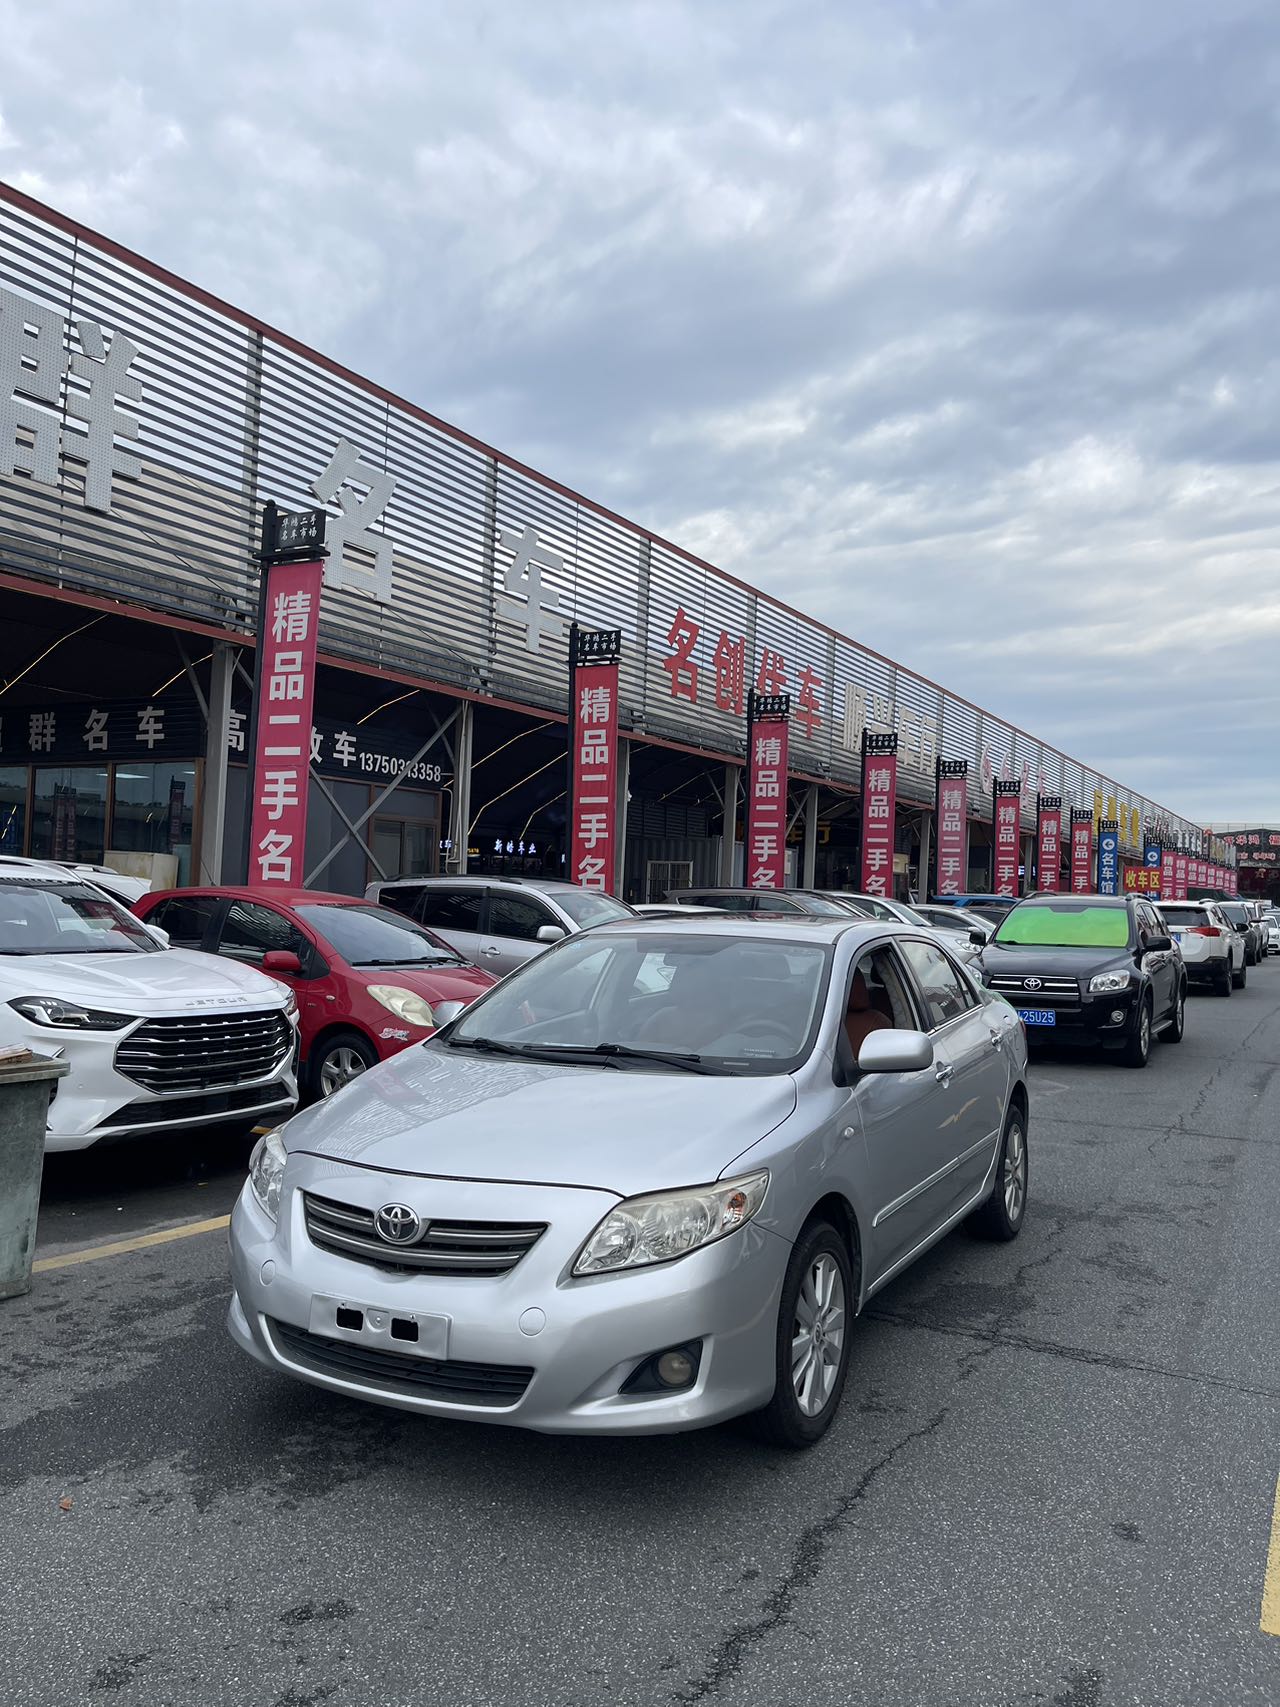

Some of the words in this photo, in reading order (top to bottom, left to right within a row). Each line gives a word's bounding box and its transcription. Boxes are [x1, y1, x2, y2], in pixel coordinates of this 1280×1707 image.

[0, 706, 166, 752] 群名车
[258, 590, 311, 882] 精品二手名
[577, 686, 611, 891] 精品二手名
[1041, 820, 1057, 891] 精品二手
[1074, 830, 1089, 893] 精品二手
[1125, 870, 1161, 889] 收车区
[1018, 1011, 1054, 1023] 25U25
